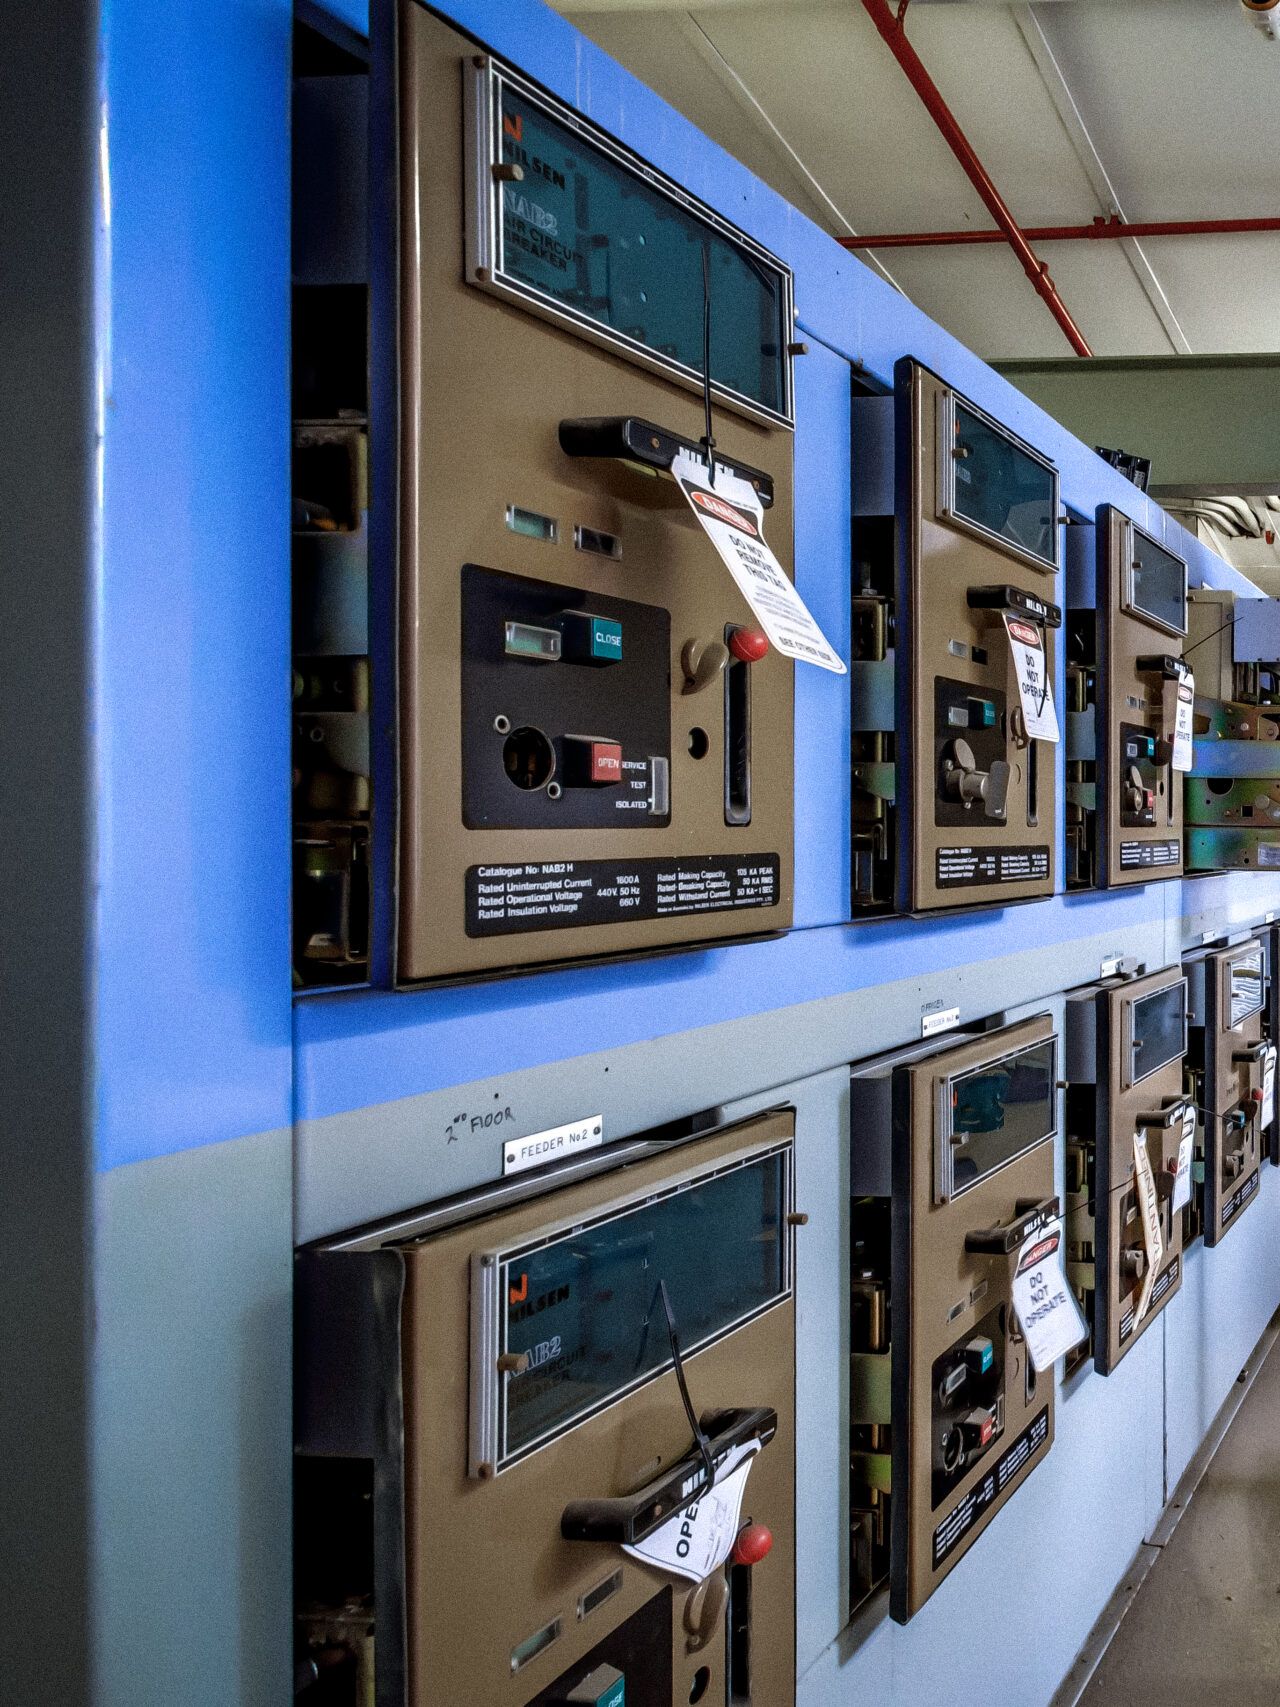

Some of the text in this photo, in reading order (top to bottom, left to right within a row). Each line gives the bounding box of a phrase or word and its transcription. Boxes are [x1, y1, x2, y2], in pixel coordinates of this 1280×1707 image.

[728, 534, 747, 550] DO
[736, 549, 777, 577] REMOVE
[595, 632, 622, 647] CLOSE
[1025, 654, 1035, 668] DO
[1026, 669, 1039, 683] NOT
[598, 757, 620, 769] OPEN
[630, 781, 647, 789] TEST
[615, 801, 648, 809] ISOLATED
[478, 865, 522, 878] Catalogue
[542, 864, 565, 874] NAB2
[657, 873, 676, 882] Rated
[678, 871, 700, 881] Making
[700, 870, 726, 880] Capacity
[759, 867, 773, 875] PEAK
[478, 883, 504, 894] Rated
[506, 879, 562, 892] Uninterrupted
[563, 878, 593, 888] Current
[657, 884, 676, 893] Rated
[705, 880, 731, 890] Capacity
[478, 895, 504, 907] Rated
[506, 892, 553, 905] Operational
[554, 891, 583, 901] Voltage
[630, 887, 640, 895] Hz
[657, 894, 676, 904] Rated
[709, 890, 731, 900] Current
[478, 909, 504, 920] Rated
[507, 905, 548, 917] Insulation
[549, 902, 579, 914] Voltage
[521, 1136, 564, 1159] FEEDER
[1030, 1272, 1043, 1288] DO
[1030, 1284, 1049, 1305] NOT
[676, 1500, 702, 1559] OPE
